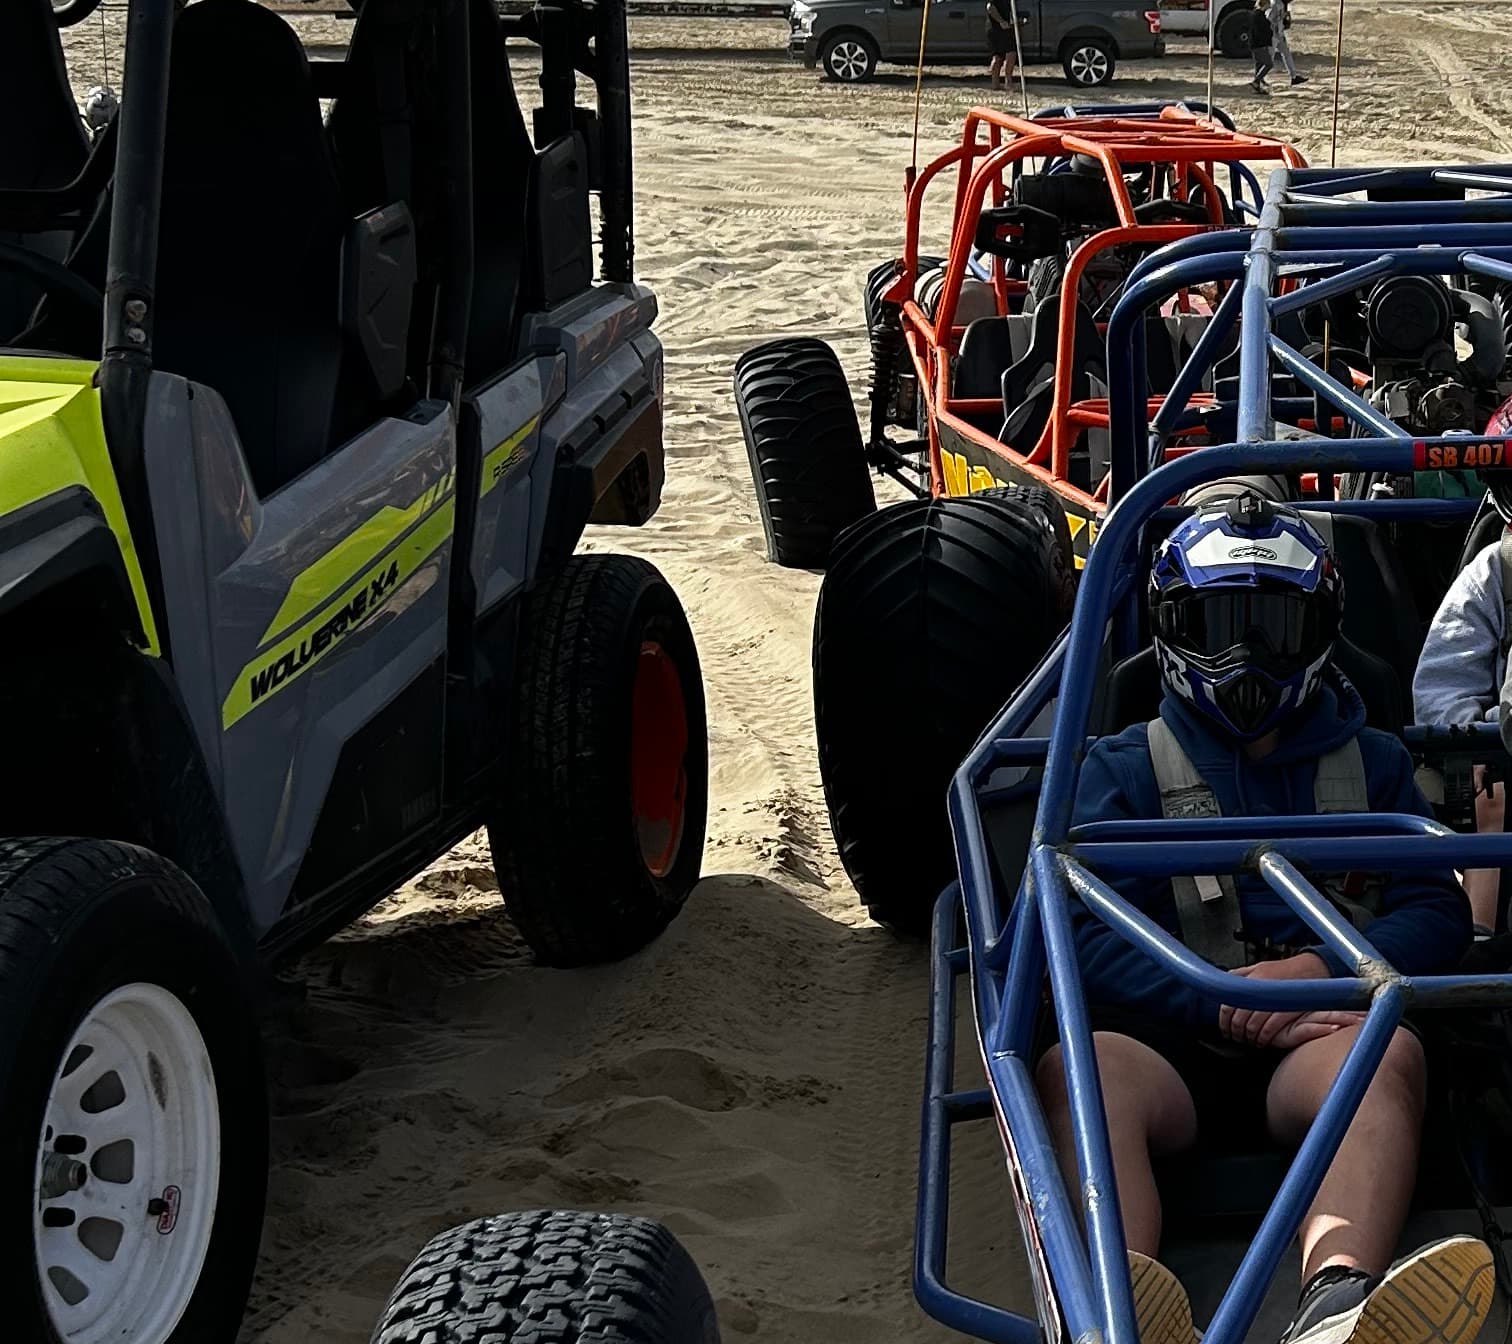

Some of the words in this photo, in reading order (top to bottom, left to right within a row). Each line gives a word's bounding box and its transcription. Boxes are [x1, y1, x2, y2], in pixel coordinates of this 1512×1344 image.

[1428, 446, 1458, 468] SB
[1463, 443, 1504, 466] 407
[251, 587, 369, 703] WOLVERINE
[370, 560, 399, 607] X4
